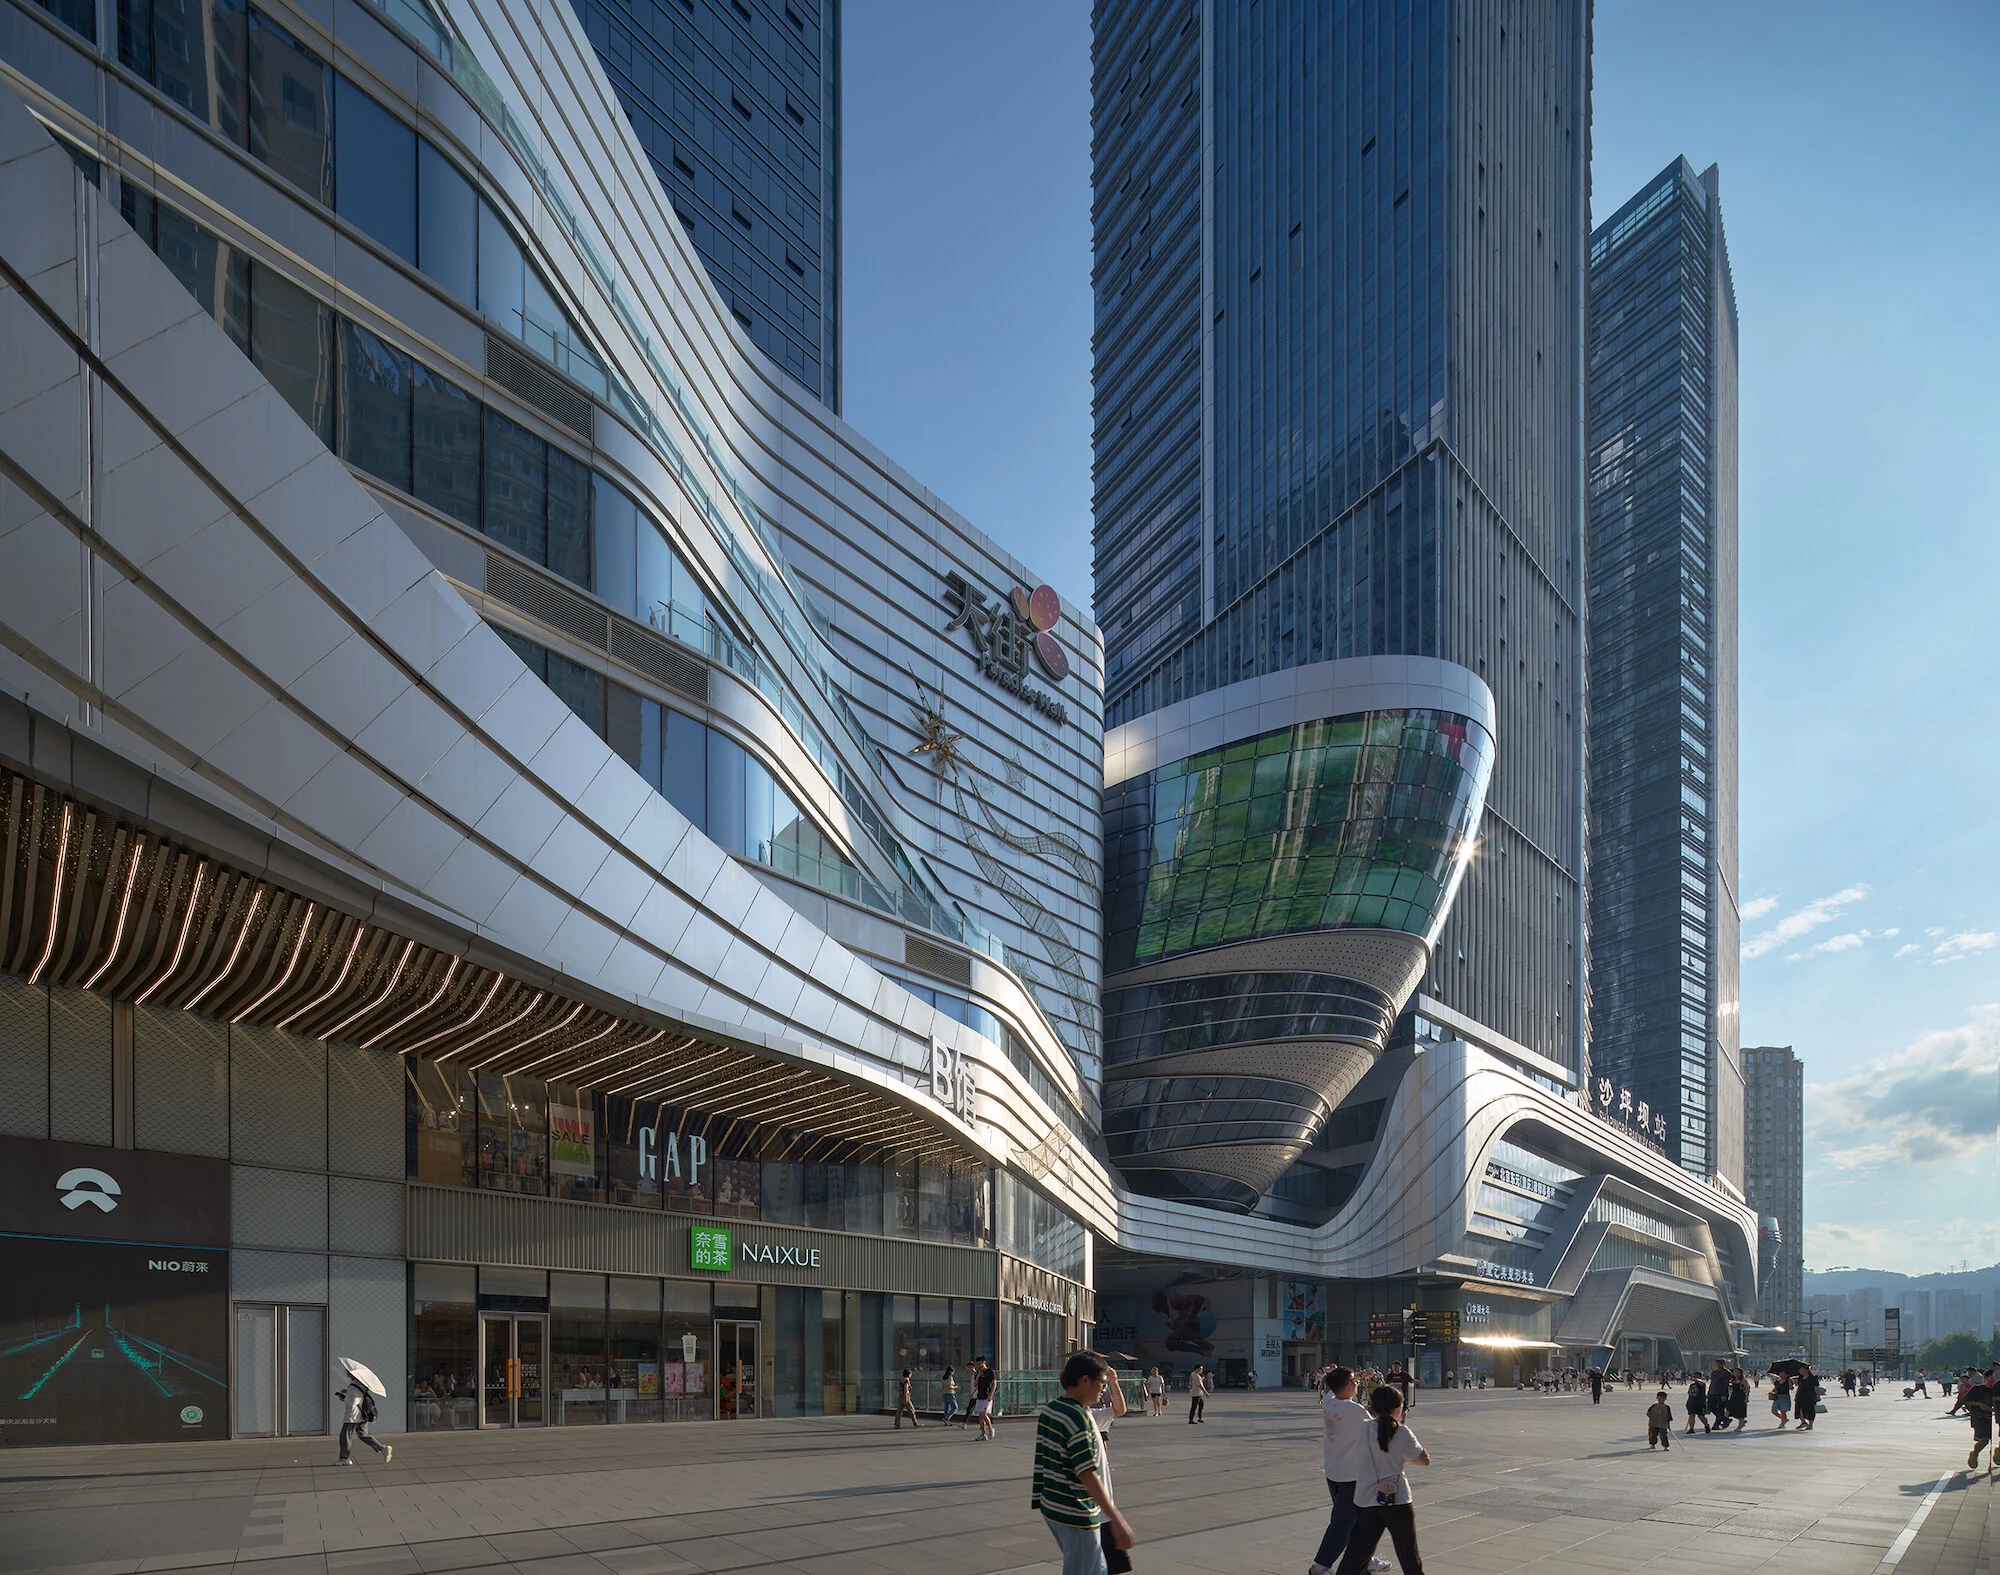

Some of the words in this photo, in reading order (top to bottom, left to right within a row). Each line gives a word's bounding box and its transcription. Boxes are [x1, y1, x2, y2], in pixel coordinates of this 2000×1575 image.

[943, 569, 1034, 680] 天街
[1598, 1077, 1667, 1142] 沙坪坝站
[551, 1129, 590, 1145] SALE
[639, 1126, 707, 1186] GAP
[695, 1231, 728, 1250] 奈雪
[148, 1259, 181, 1272] NIO
[695, 1248, 728, 1266] 的茶
[742, 1242, 821, 1268] NAIXUE
